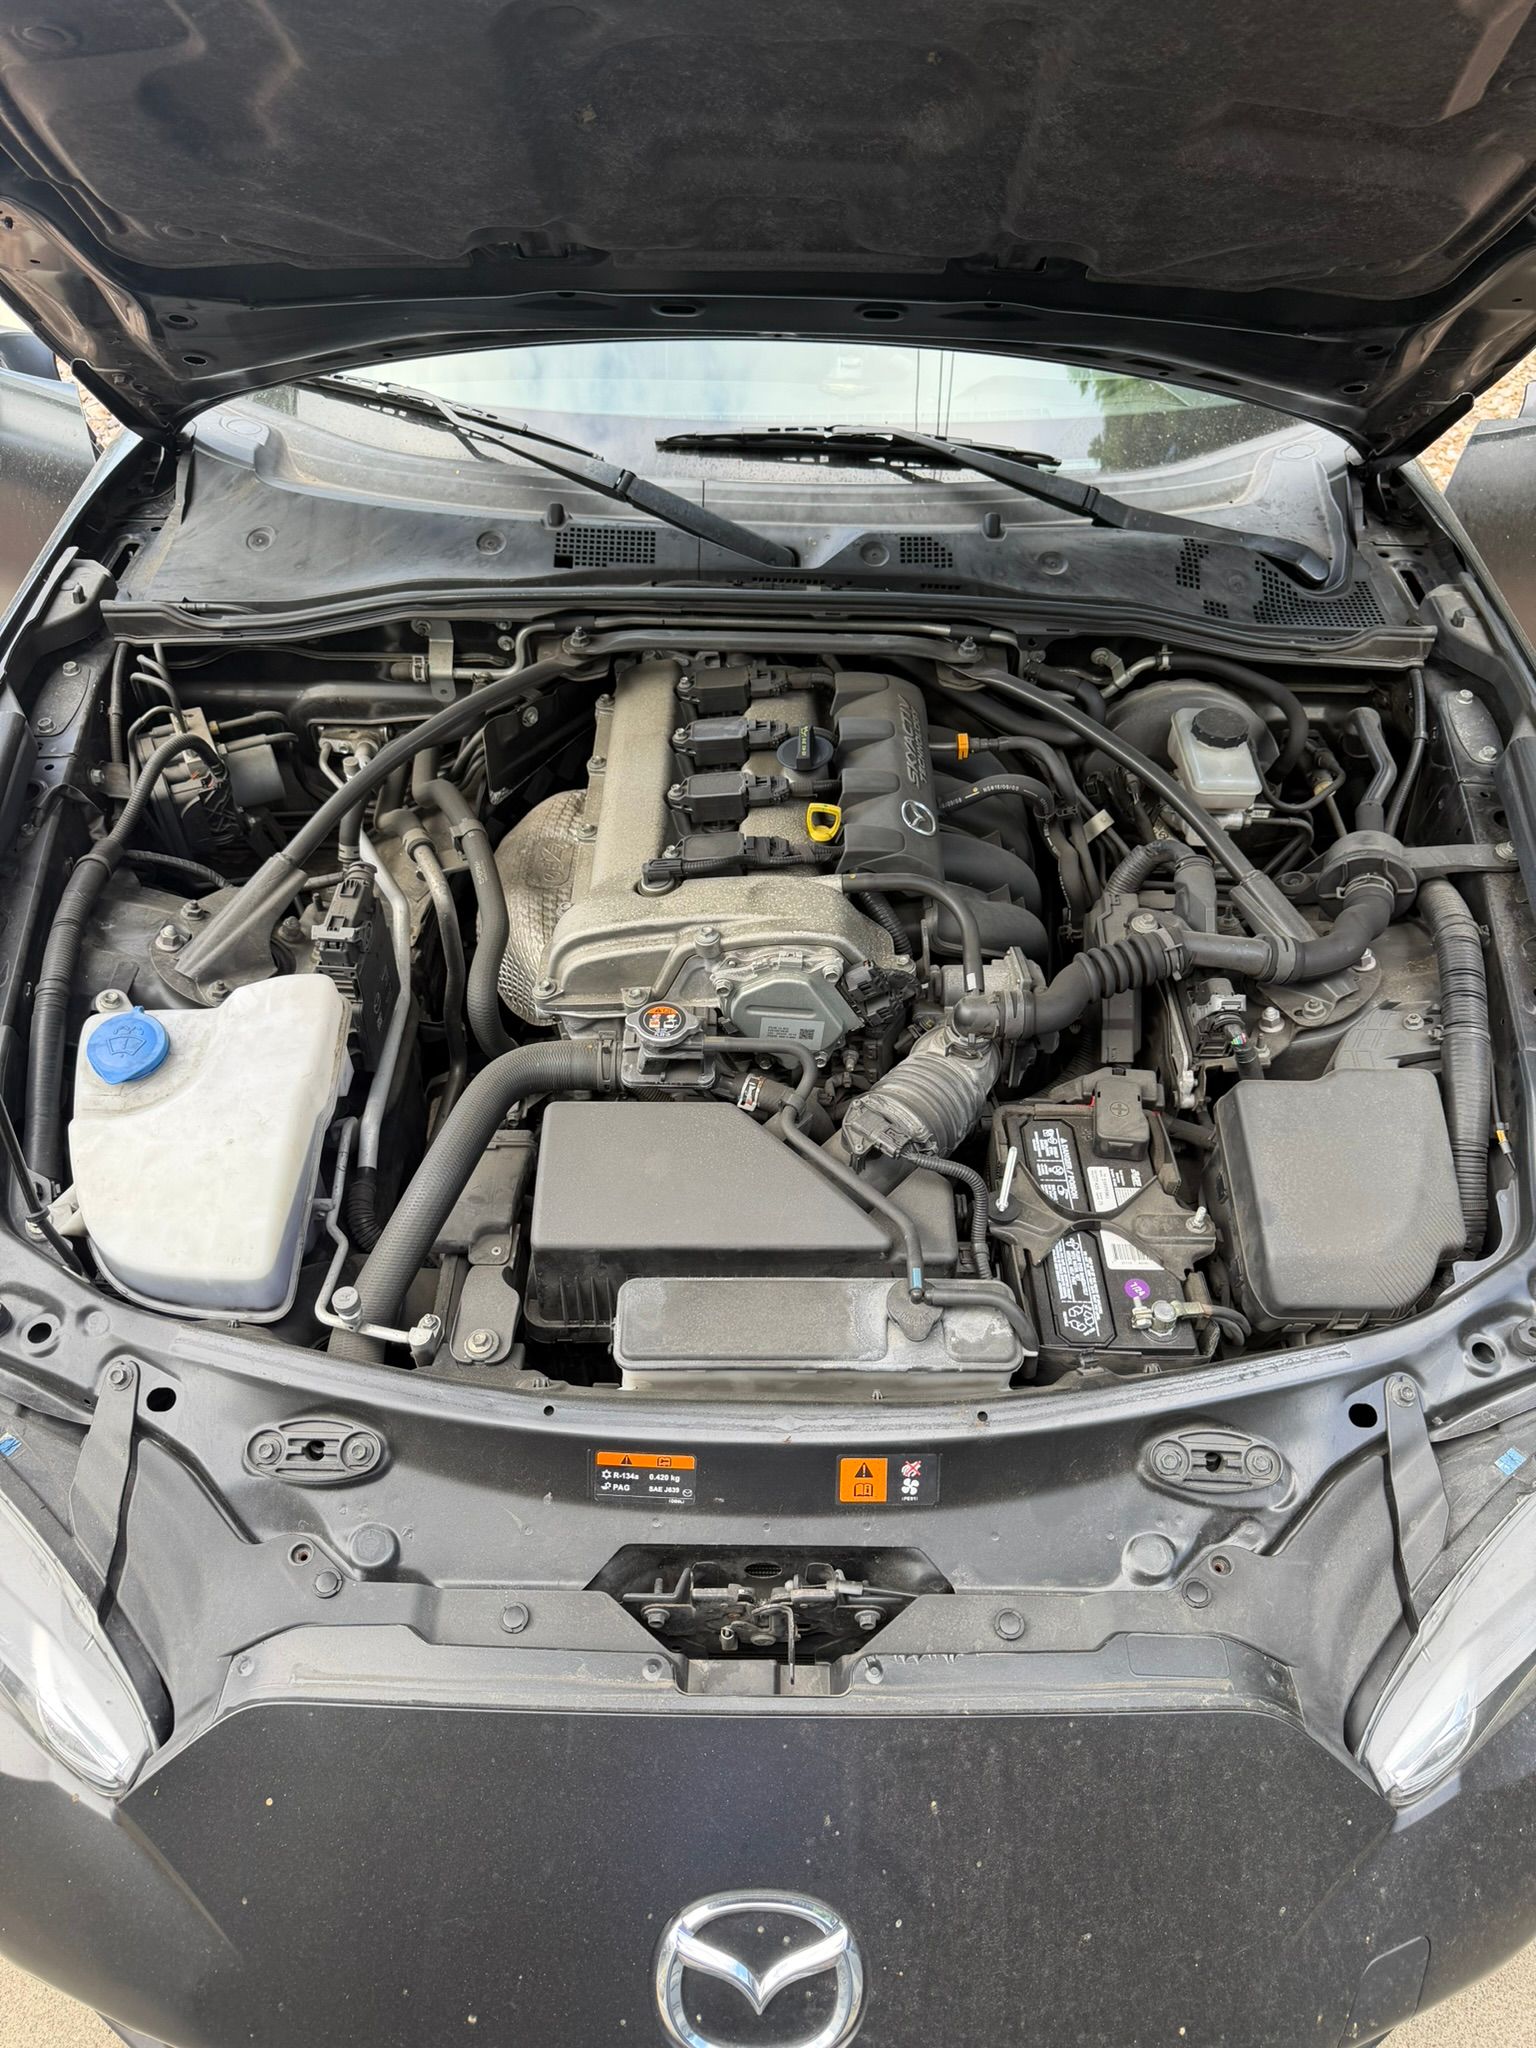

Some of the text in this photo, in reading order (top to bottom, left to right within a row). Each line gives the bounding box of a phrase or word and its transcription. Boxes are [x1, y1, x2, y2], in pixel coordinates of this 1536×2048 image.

[898, 693, 919, 789] SKYACTIV
[612, 1471, 680, 1484] R-134a 0.420 kg
[612, 1483, 631, 1492] PAG
[648, 1485, 663, 1493] SAE
